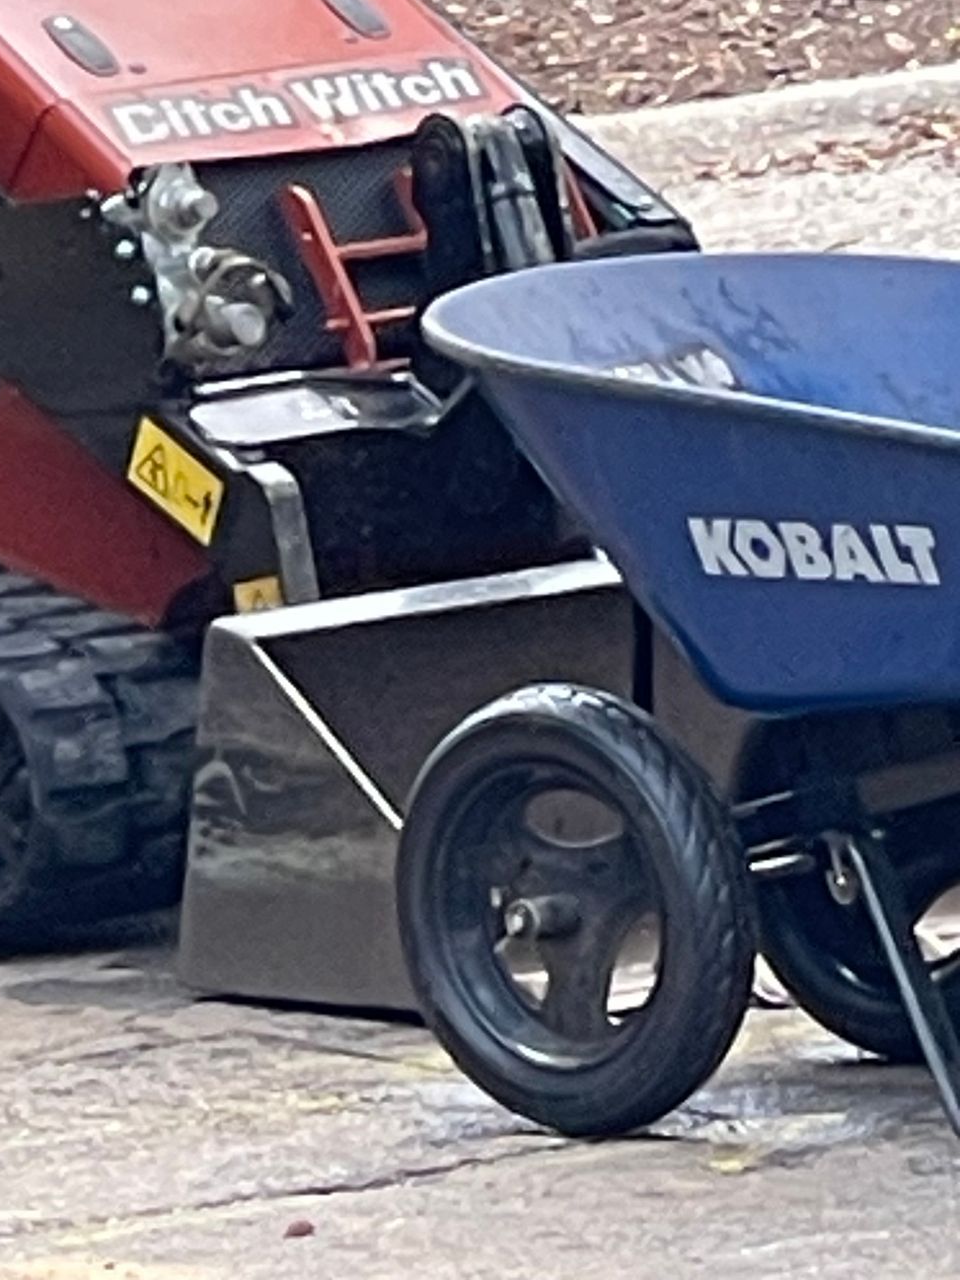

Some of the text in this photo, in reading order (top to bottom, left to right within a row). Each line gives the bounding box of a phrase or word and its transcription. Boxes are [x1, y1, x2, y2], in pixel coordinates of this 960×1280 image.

[112, 60, 481, 145] Ditch Witch
[687, 517, 941, 585] KOBALT
